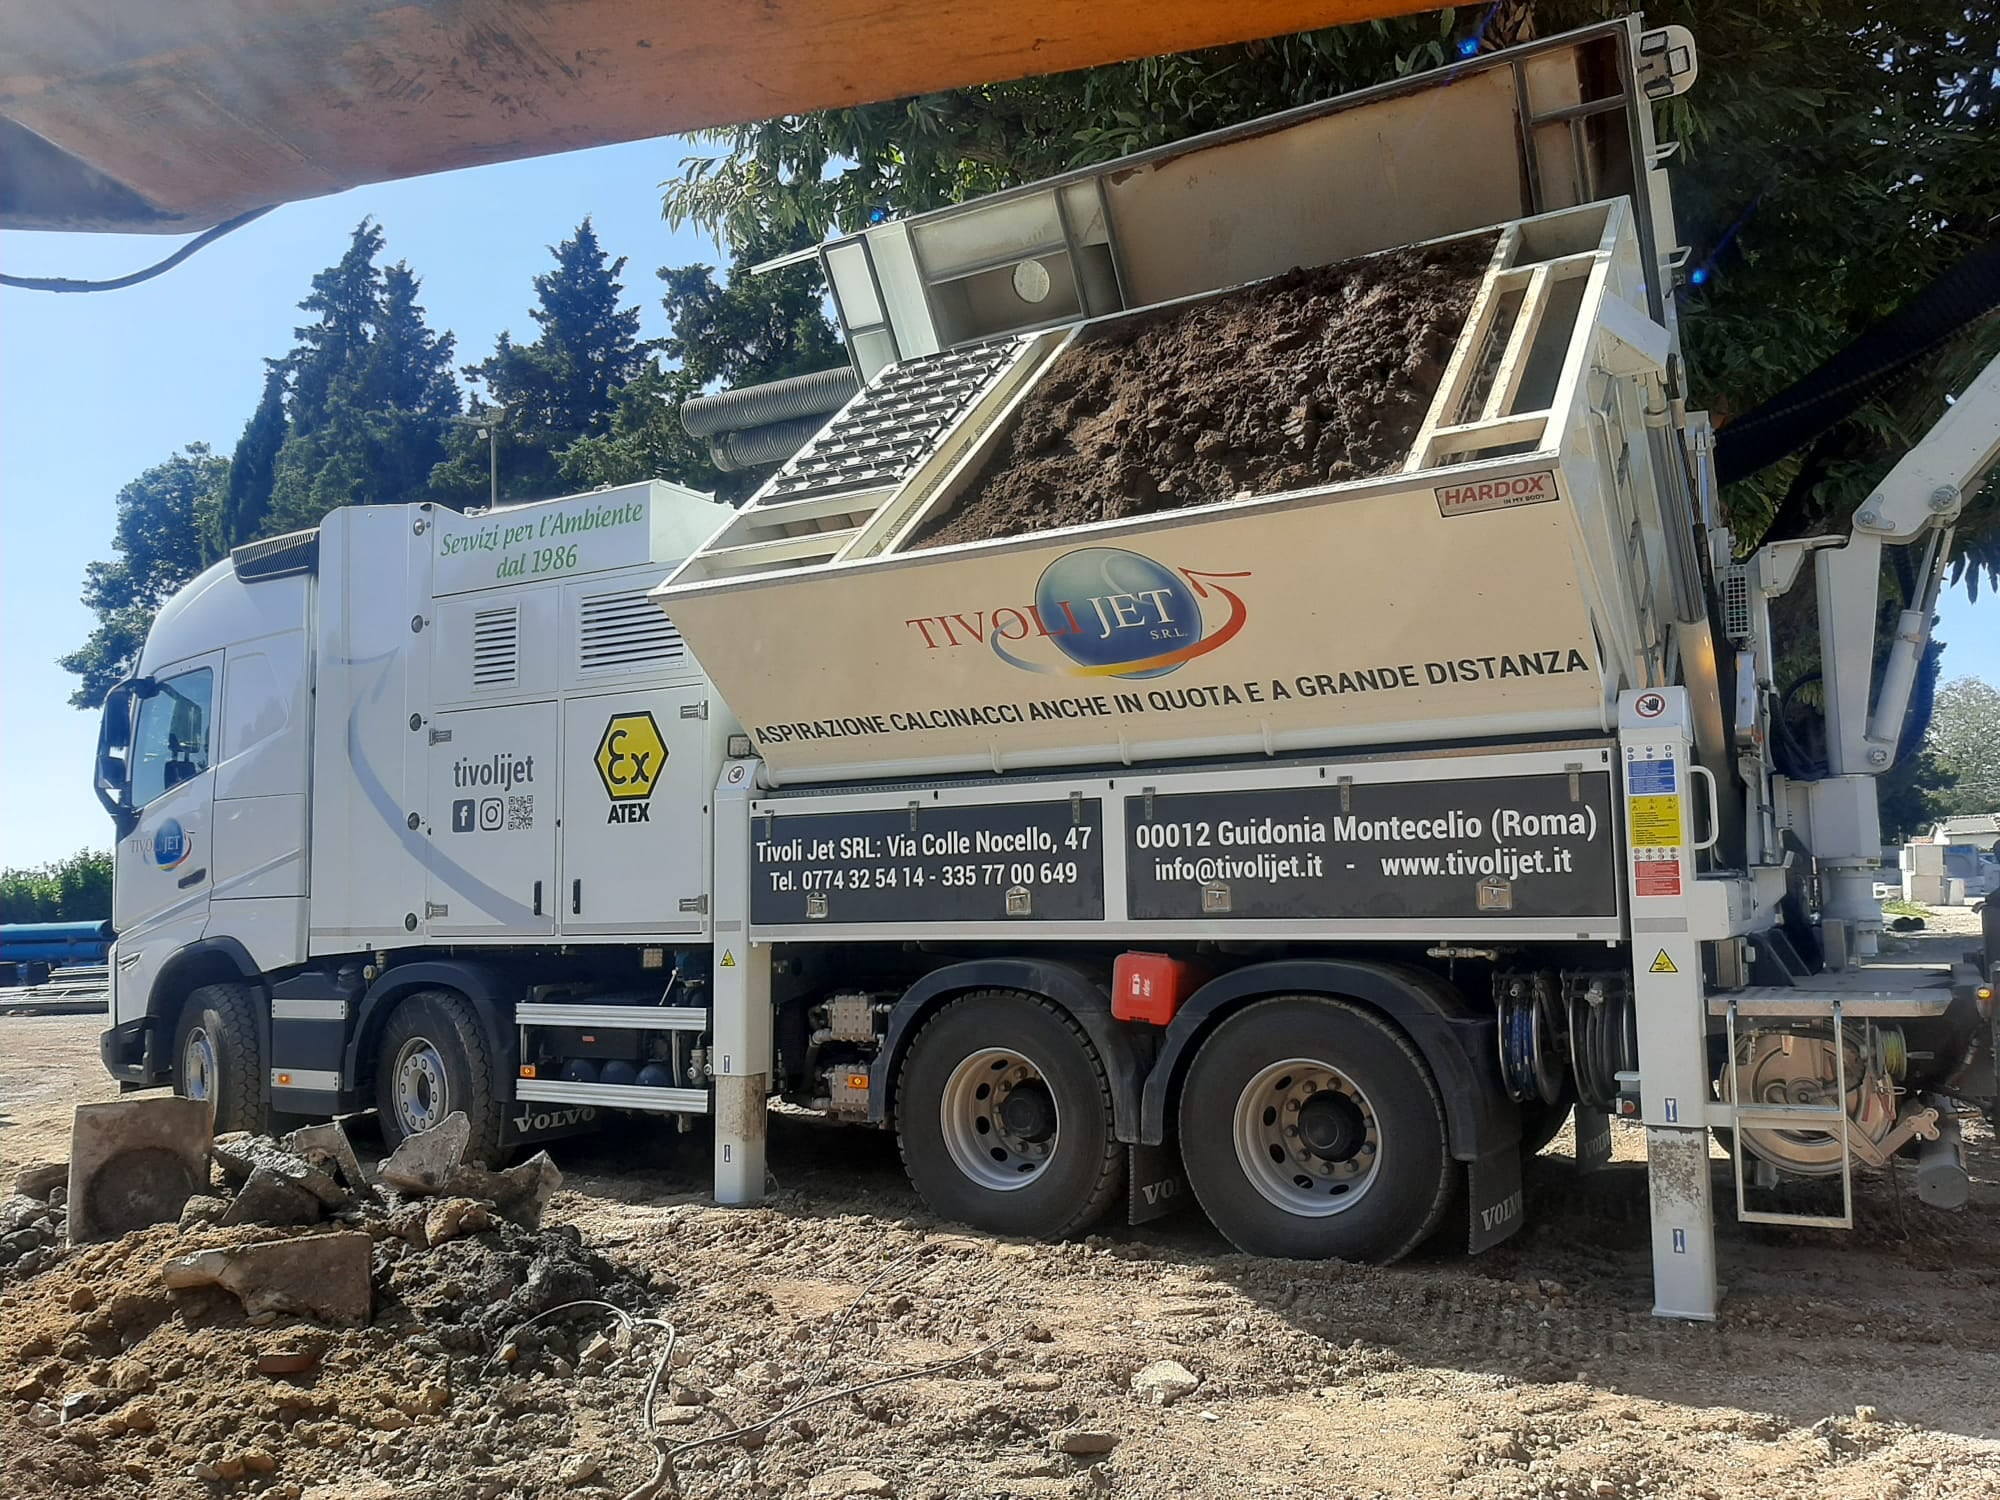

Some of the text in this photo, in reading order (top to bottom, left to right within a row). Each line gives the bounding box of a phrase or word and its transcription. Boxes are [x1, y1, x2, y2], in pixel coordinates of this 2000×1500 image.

[1445, 475, 1544, 505] HARDOX
[440, 524, 499, 556] Servizi
[503, 523, 533, 549] per
[496, 544, 578, 579] dal 1986
[905, 588, 1175, 649] TIVOLI JET
[1150, 627, 1189, 640] S.R.L.
[754, 648, 1590, 745] ASPIRAZIONE CALCINACCI ANCHE IN QUOTA E A GRANDE DISTANZA
[453, 753, 534, 791] tivolijet
[607, 803, 650, 824] ATEX
[1135, 822, 1211, 849] 00012
[1217, 816, 1326, 846] Guidonia
[1333, 810, 1482, 841] Montecelio
[1491, 804, 1597, 844] (Roma)
[756, 826, 1092, 863] Tivoli Jet SRL: Via Colle Nocello, 47
[770, 871, 797, 892] Tel.
[802, 868, 844, 891] 0774
[849, 867, 870, 890] 32
[875, 867, 897, 888] 54
[902, 866, 924, 887] 14
[942, 864, 976, 887] 335
[981, 864, 1005, 885] 77
[1010, 863, 1035, 885] 00
[1040, 861, 1078, 884] 649
[1154, 853, 1323, 885] info@tivolijet.it
[1380, 847, 1573, 880] www.tivolijet.it
[513, 1106, 596, 1133] VOLVO
